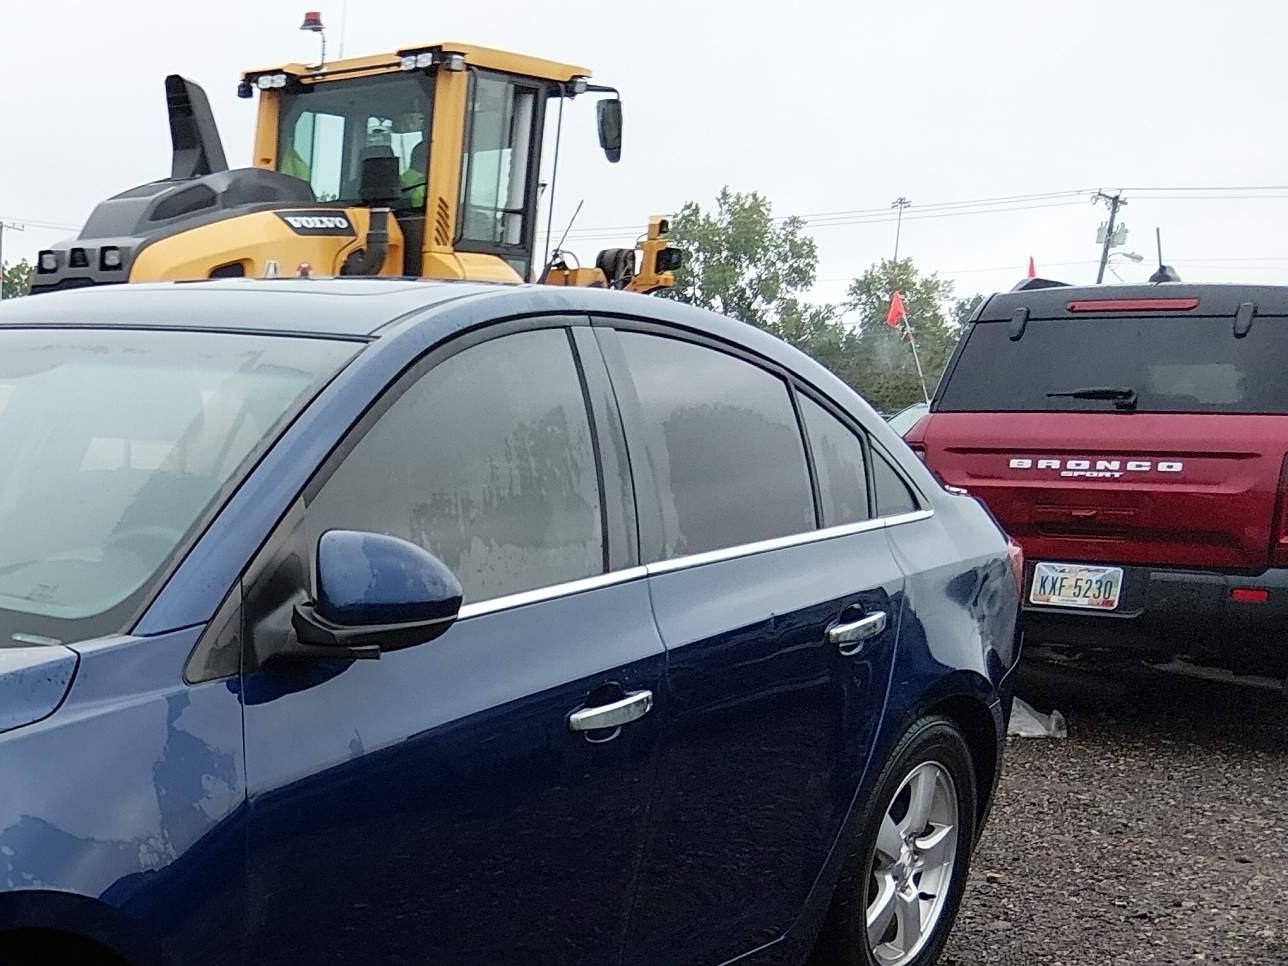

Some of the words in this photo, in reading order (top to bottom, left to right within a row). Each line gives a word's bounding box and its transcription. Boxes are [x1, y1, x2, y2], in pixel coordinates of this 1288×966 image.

[284, 216, 349, 229] VOLVO
[1009, 458, 1184, 472] BRONCO
[1060, 470, 1124, 478] SPORT
[1038, 575, 1070, 598] KXF
[1072, 577, 1114, 600] 5230
